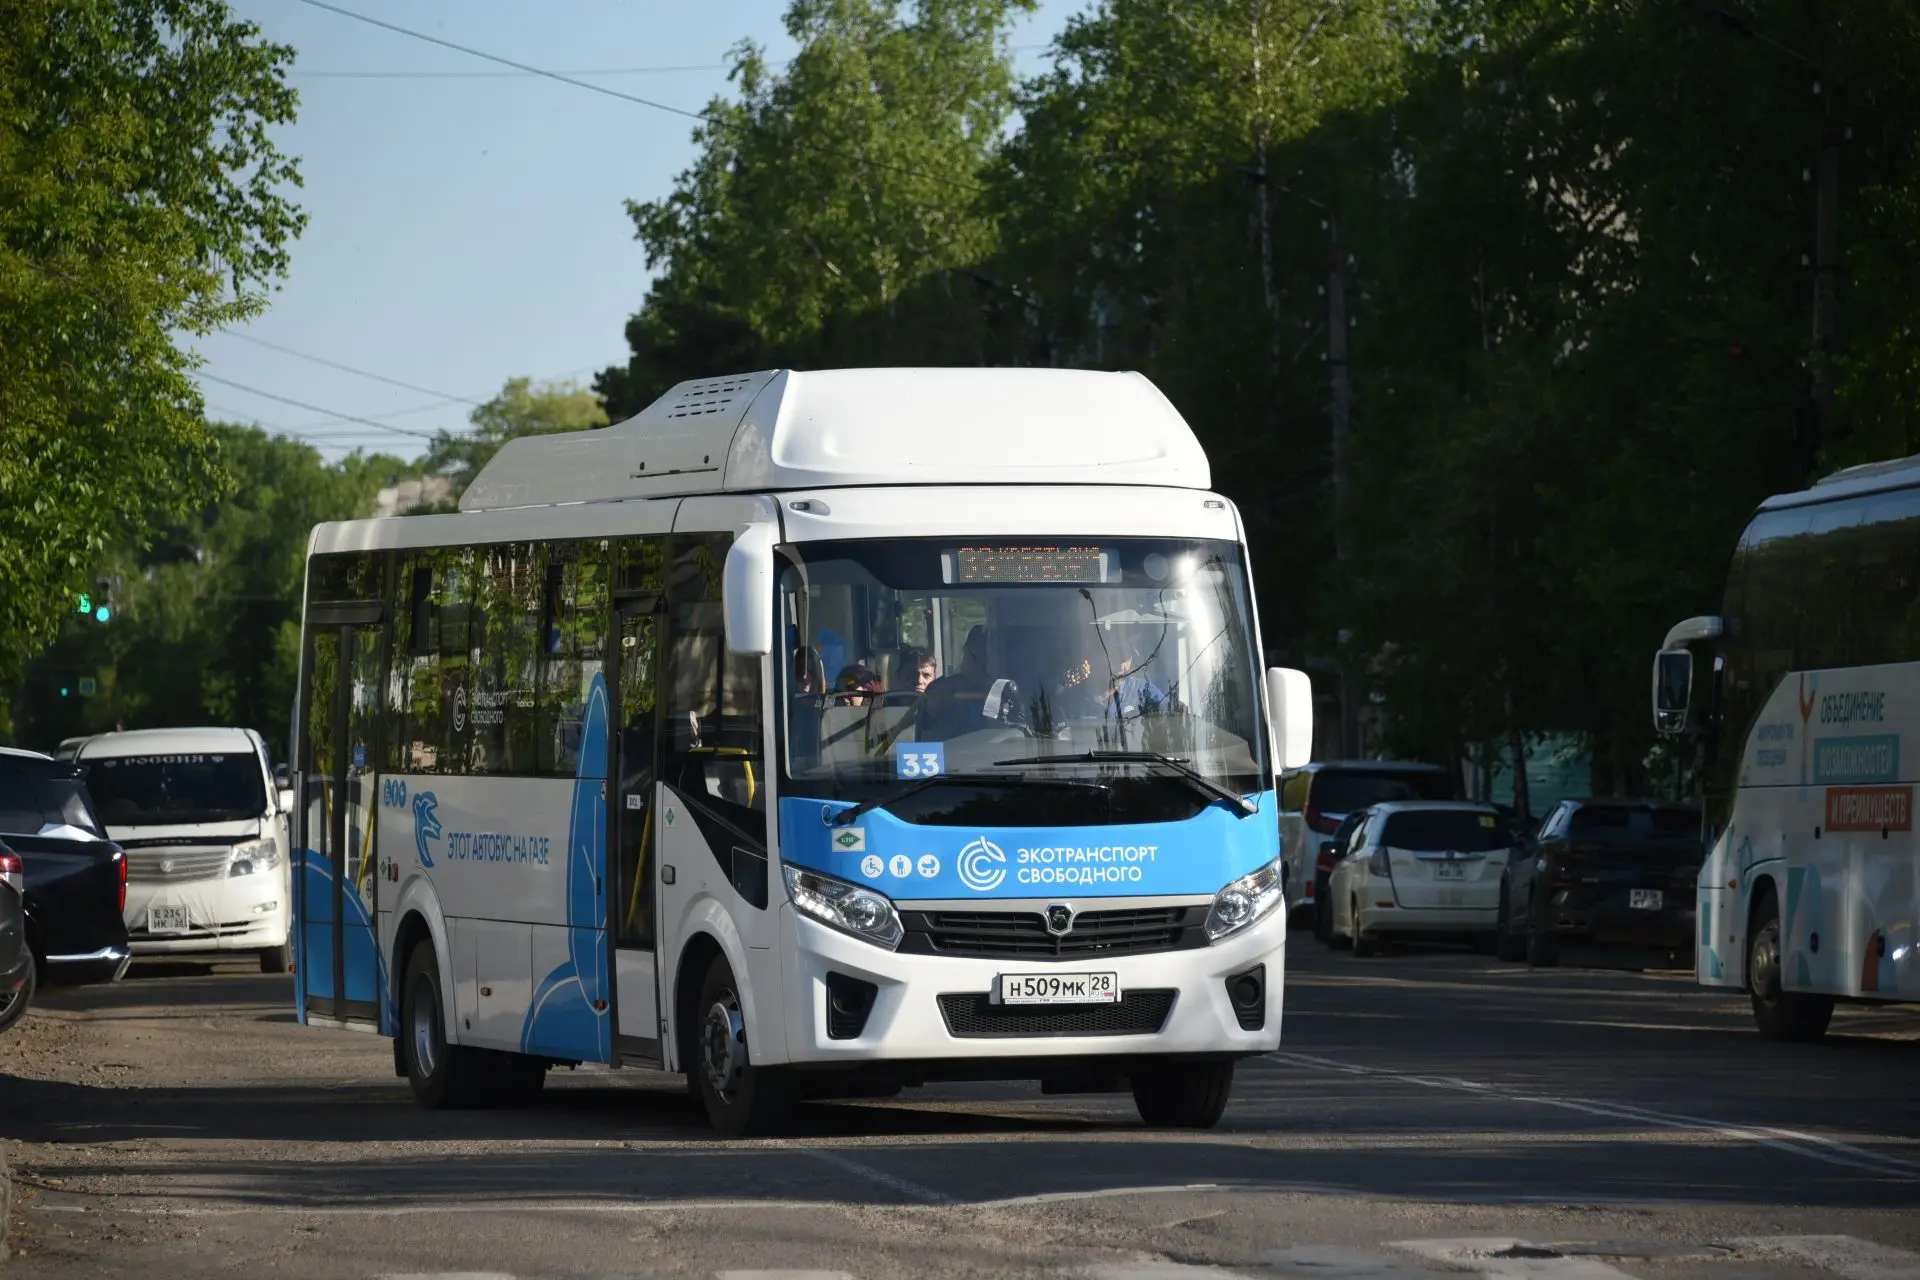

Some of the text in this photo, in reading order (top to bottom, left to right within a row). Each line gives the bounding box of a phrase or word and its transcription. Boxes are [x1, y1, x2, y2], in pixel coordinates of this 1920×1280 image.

[1821, 692, 1884, 728] ОБЪЕДИНЕНИЕ
[903, 753, 940, 777] 33
[1820, 739, 1892, 776] ВОЗМОЖНОСТЕЙ
[1842, 793, 1907, 827] ПРЕИМУЩЕСТВ
[447, 832, 549, 865] ЭТОТ АВТОБУС НА ГАЗЕ
[1017, 845, 1158, 864] ЭКОТРАНСПОРТ
[1017, 865, 1142, 885] СВОБОДНОГО
[1092, 976, 1110, 990] 28
